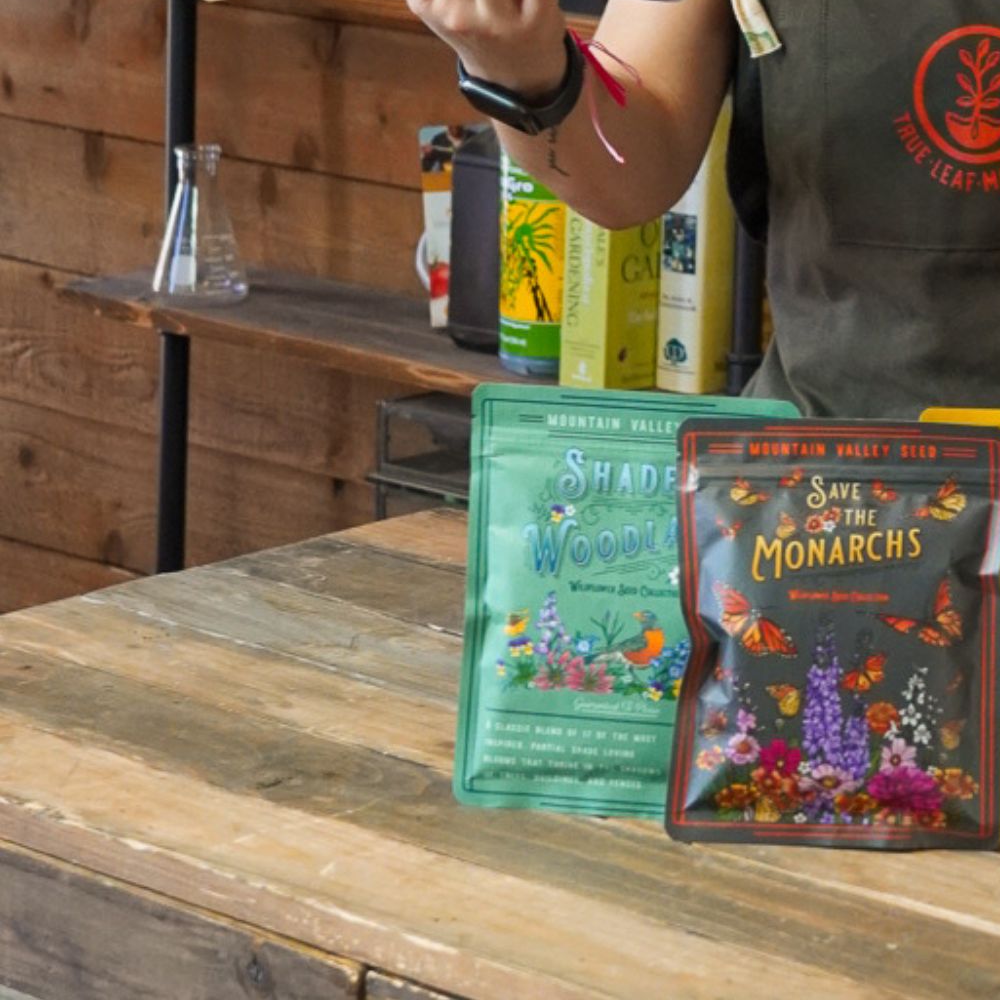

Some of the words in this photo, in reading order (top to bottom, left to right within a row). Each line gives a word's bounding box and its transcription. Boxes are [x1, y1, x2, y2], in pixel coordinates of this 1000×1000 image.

[894, 111, 931, 165] TRUE
[930, 158, 976, 193] LEAF
[566, 216, 582, 328] GARDENING
[547, 414, 620, 430] MOUNTAIN
[749, 442, 825, 456] MOUNTAIN
[836, 442, 890, 457] VALLEY
[901, 444, 937, 458] SEED
[557, 447, 676, 500] SHADE
[806, 474, 861, 509] SAVE
[844, 509, 876, 526] THE
[752, 528, 922, 582] MONARCHS
